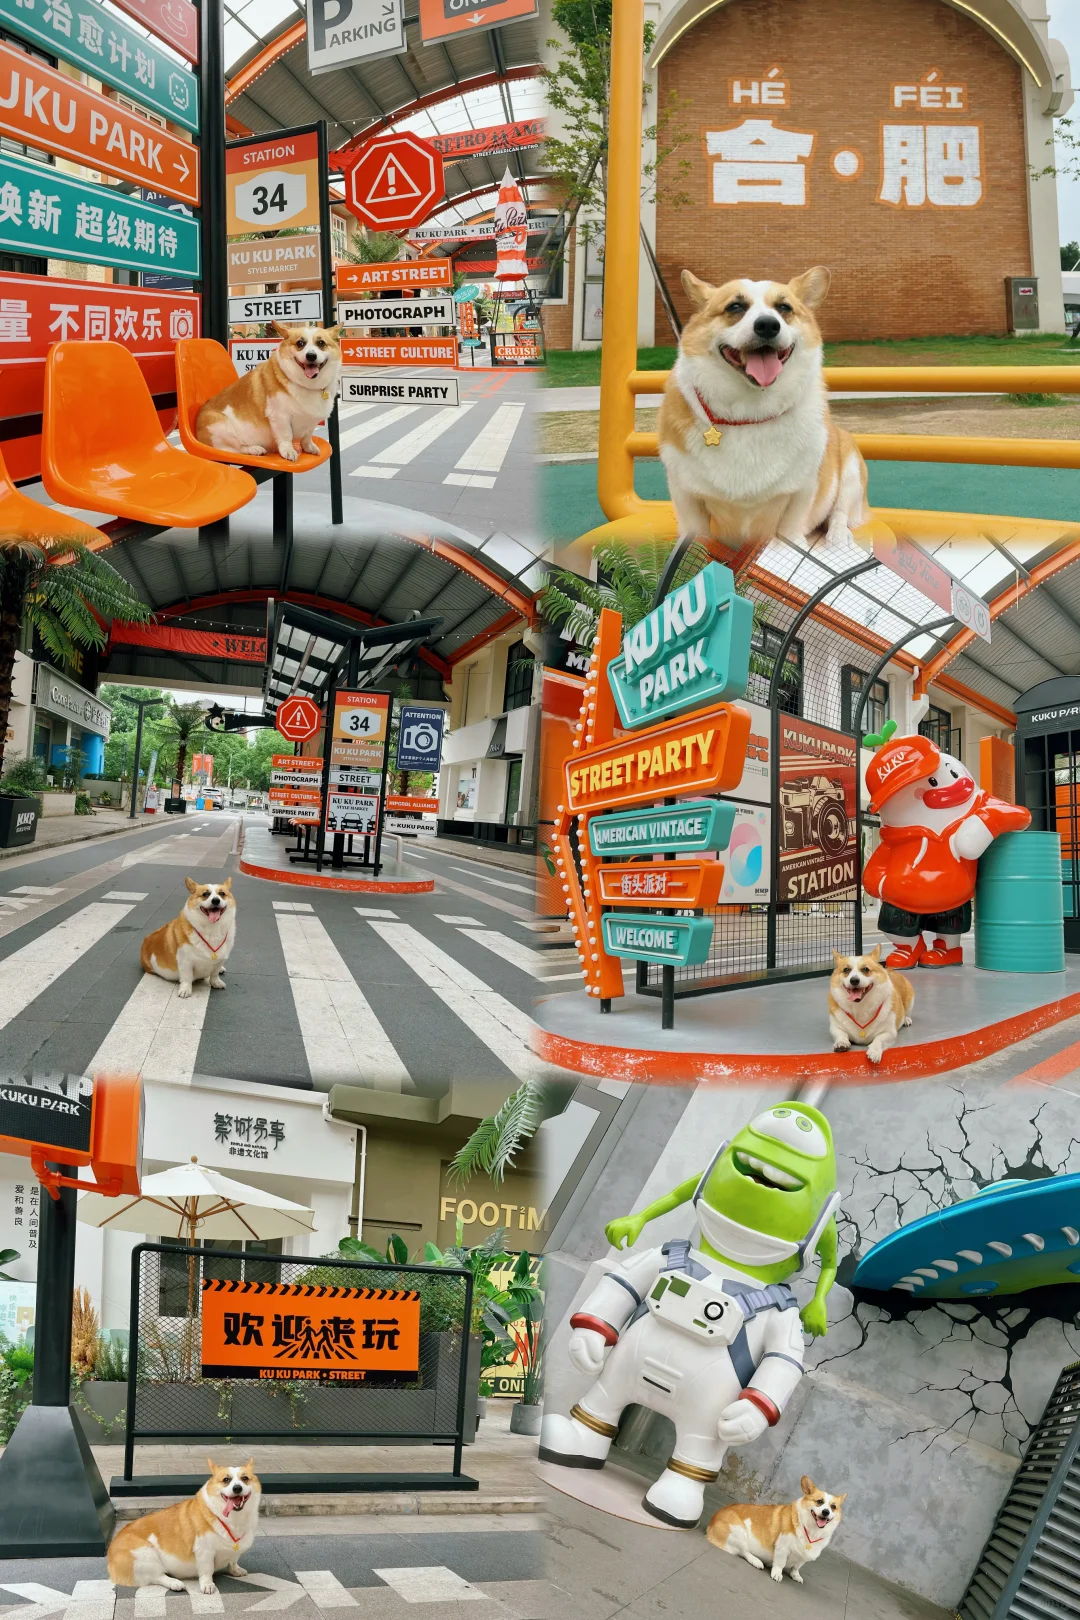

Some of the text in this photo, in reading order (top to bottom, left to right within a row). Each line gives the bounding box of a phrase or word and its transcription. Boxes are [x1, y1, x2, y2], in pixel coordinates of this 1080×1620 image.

[16, 0, 156, 89] 治愈计划
[732, 67, 963, 109] HÉ FÉI
[90, 110, 163, 174] PARK
[243, 144, 295, 164] STATION
[252, 183, 287, 215] 34
[75, 202, 178, 259] 超级期待
[443, 228, 468, 236] PARK
[231, 245, 316, 265] KU KU PARK
[247, 263, 298, 275] STYLE MARKET
[361, 267, 447, 283] ART STREET
[244, 299, 302, 317] STREET
[345, 305, 445, 320] PHOTOGRAPH
[48, 303, 163, 342] 不同欢乐
[236, 349, 254, 360] KU
[355, 346, 453, 359] STREET CULTURE
[498, 347, 537, 355] CRUISE
[349, 384, 448, 398] SURPRISE PARTY
[623, 571, 707, 674] KUKU
[639, 637, 709, 709] PARK
[347, 696, 377, 704] STATION
[349, 715, 370, 732] 34
[404, 711, 442, 720] ATTENTION
[1031, 710, 1057, 723] KUKU
[333, 747, 382, 758] KU KU PARK
[783, 728, 822, 758] KUKU
[822, 740, 856, 767] PARK
[290, 759, 315, 767] STREET
[570, 753, 635, 798] STREET
[637, 729, 715, 780] PARTY
[274, 775, 318, 784] PHOTOGRAPH
[339, 774, 371, 784] STREET
[271, 791, 289, 799] STREET
[271, 808, 315, 817] SURPRISE PARTY
[596, 817, 702, 845] AMERICAN VINTAGE
[782, 855, 825, 873] AMERICAN VINTAGE
[621, 872, 668, 895] 街头派对
[787, 860, 855, 899] STATION
[615, 927, 674, 949] WELCOME
[0, 1088, 80, 1117] KUKU PARK
[229, 1147, 269, 1159] 非遗文化馆
[14, 1184, 24, 1226] 爱和善良
[28, 1186, 39, 1248] 是在人间普及
[223, 1312, 401, 1351] 欢迎来玩
[259, 1369, 367, 1381] KU KU PARK STREET
